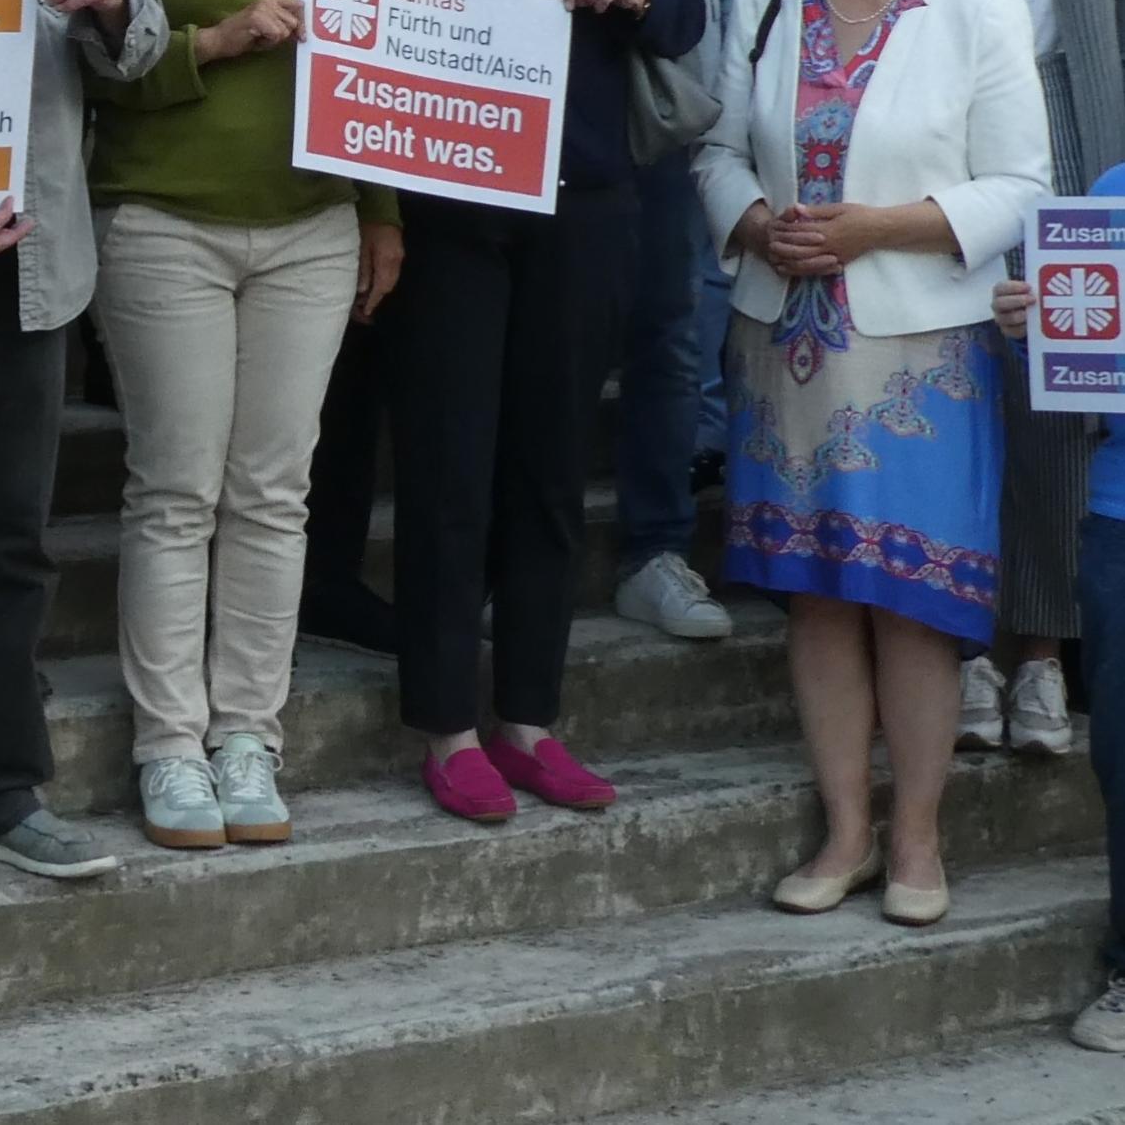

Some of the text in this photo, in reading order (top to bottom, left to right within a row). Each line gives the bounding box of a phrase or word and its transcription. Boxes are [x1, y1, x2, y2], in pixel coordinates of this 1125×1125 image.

[388, 7, 492, 46] Fürth und
[386, 36, 552, 86] Neustadt/Aisch
[334, 64, 523, 133] Zusammen
[344, 120, 503, 174] geht was.
